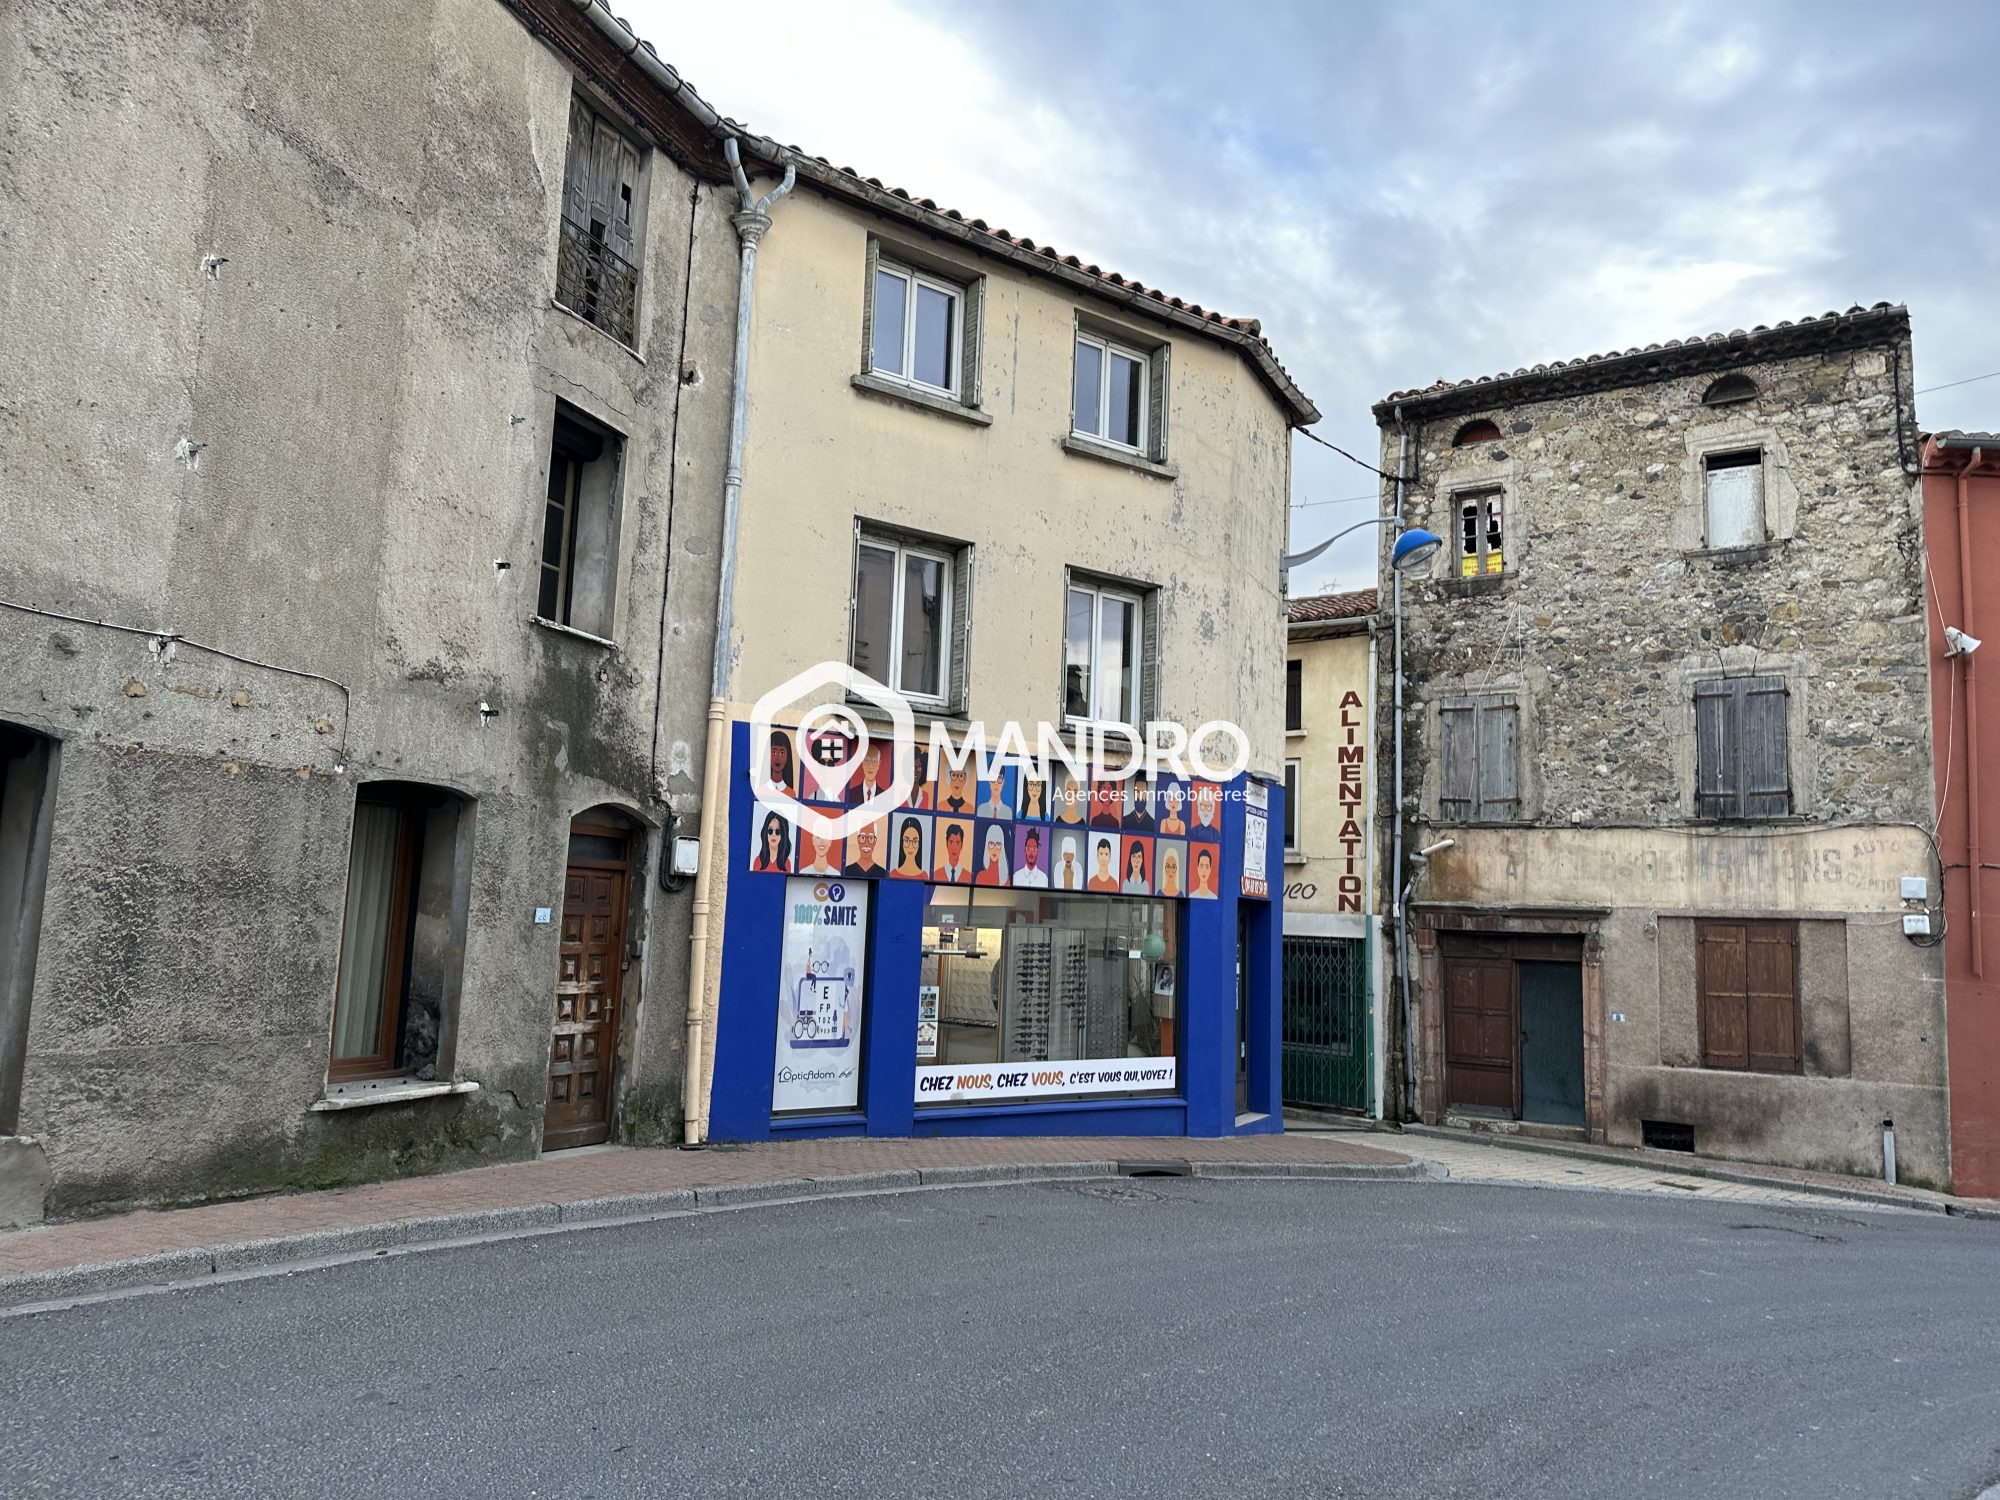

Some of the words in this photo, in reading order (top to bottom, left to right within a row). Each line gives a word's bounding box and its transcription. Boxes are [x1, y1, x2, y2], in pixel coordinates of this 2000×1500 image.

[1338, 690, 1364, 912] ALIMENTATION
[794, 904, 822, 925] 100%
[823, 986, 829, 1000] E
[783, 1069, 835, 1083] OpticAdom
[920, 1076, 954, 1092] CHEZ
[956, 1073, 994, 1090] NOUS,
[997, 1072, 1029, 1088] CHEZ
[1031, 1071, 1066, 1087] VOUS,
[1069, 1071, 1096, 1084] C'EST
[1098, 1070, 1122, 1083] VOUS
